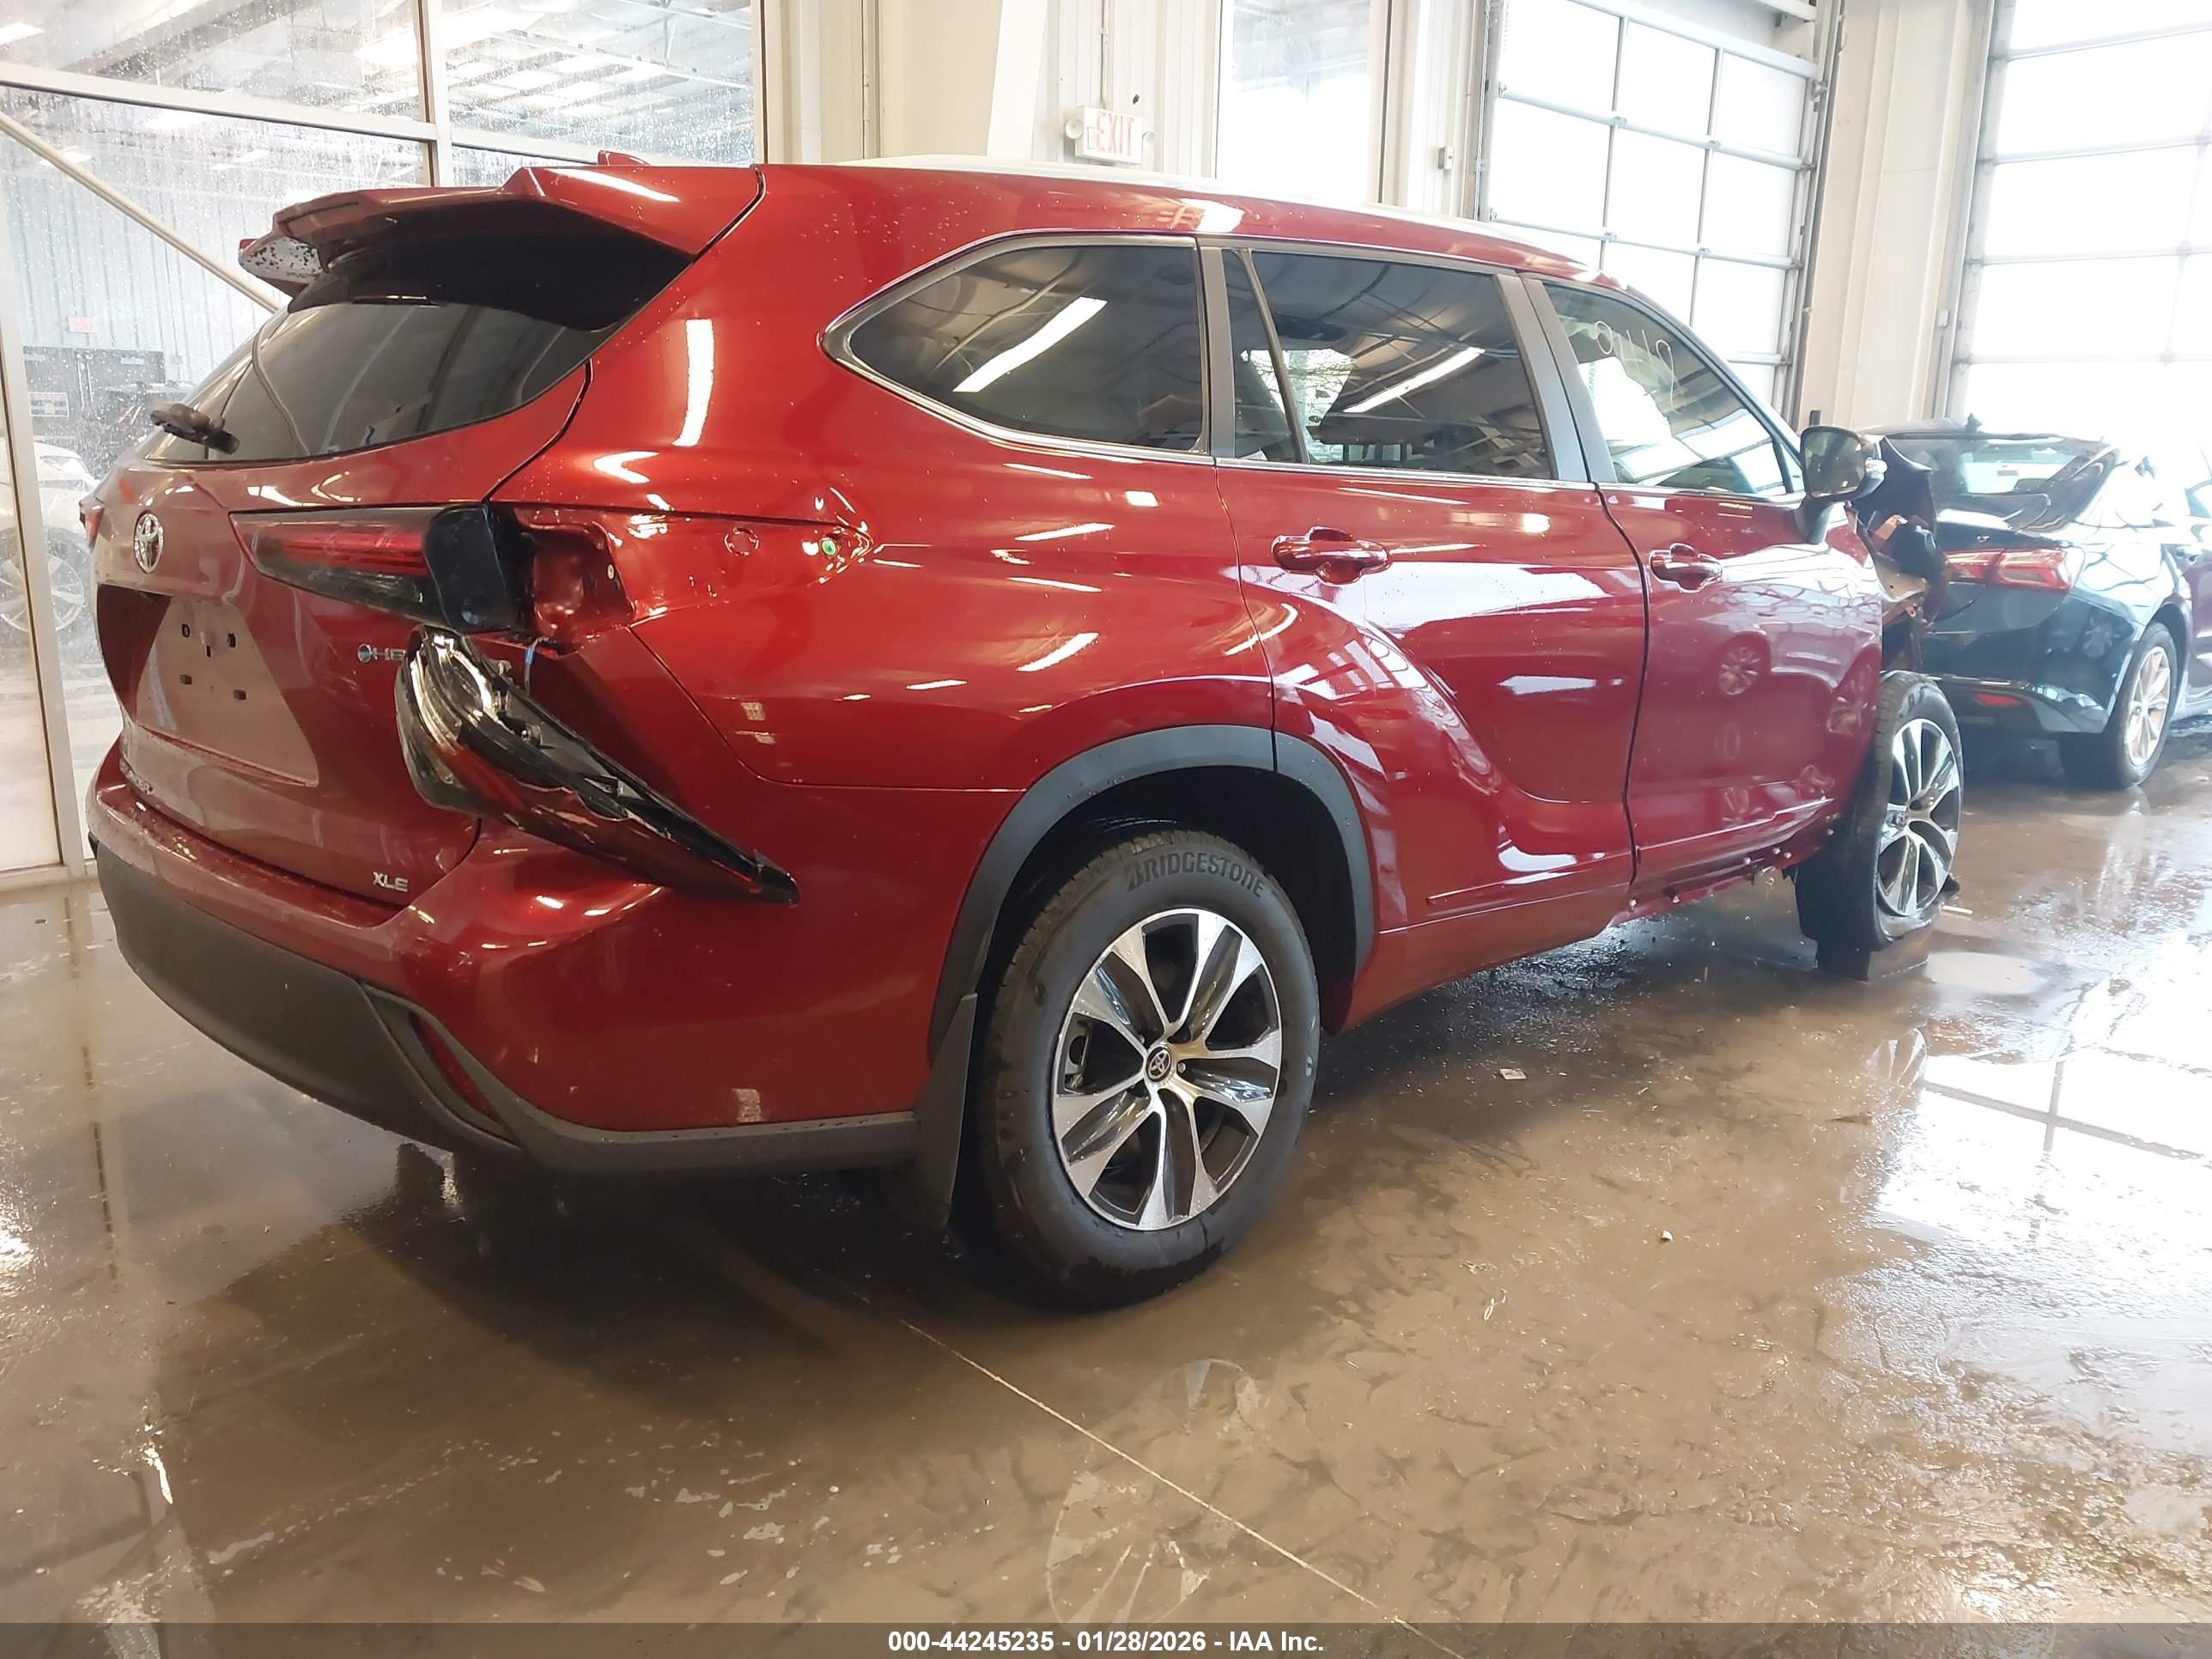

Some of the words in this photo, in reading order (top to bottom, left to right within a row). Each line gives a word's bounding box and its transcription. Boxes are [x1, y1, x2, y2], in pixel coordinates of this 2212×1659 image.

[1097, 112, 1134, 156] EXIT
[373, 872, 408, 892] XLE
[1126, 852, 1263, 897] BRIDGESTONE
